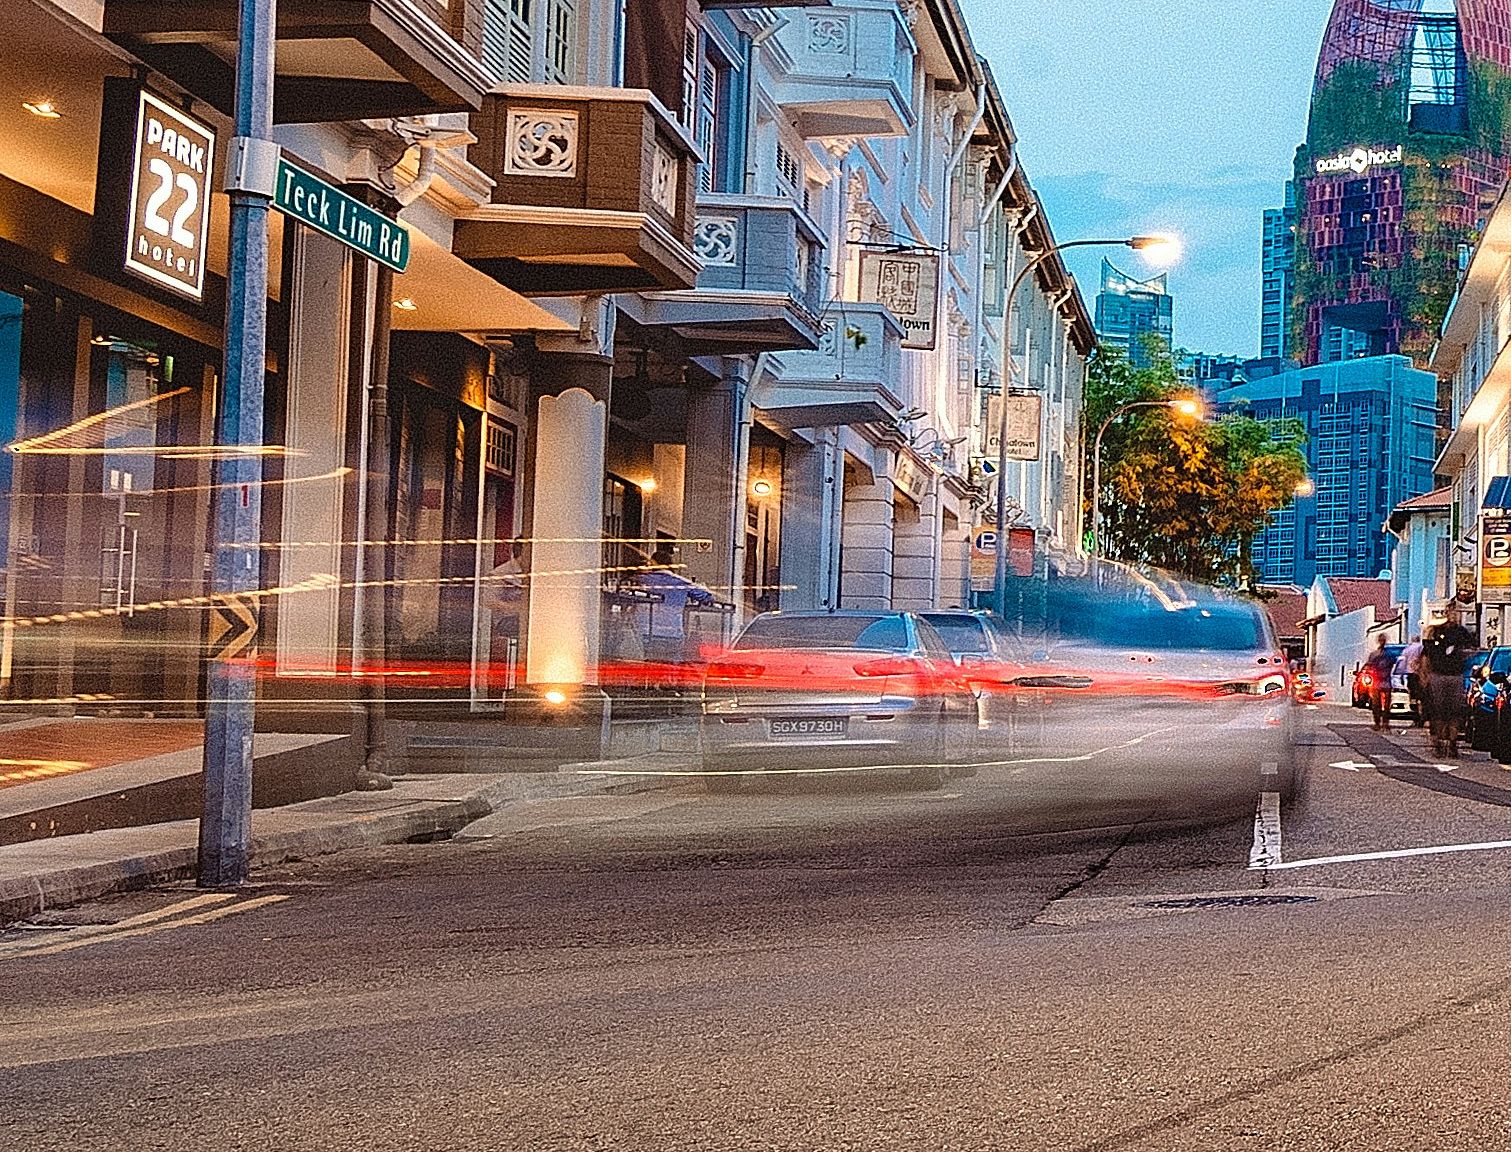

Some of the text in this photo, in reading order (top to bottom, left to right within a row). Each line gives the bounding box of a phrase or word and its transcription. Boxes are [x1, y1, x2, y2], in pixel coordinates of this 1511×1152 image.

[147, 118, 205, 174] PARK
[1367, 144, 1402, 165] hotel
[143, 157, 198, 249] 22
[284, 168, 403, 263] Teck Lim Rd
[137, 234, 196, 277] hotel
[772, 720, 843, 733] SGX9730H
